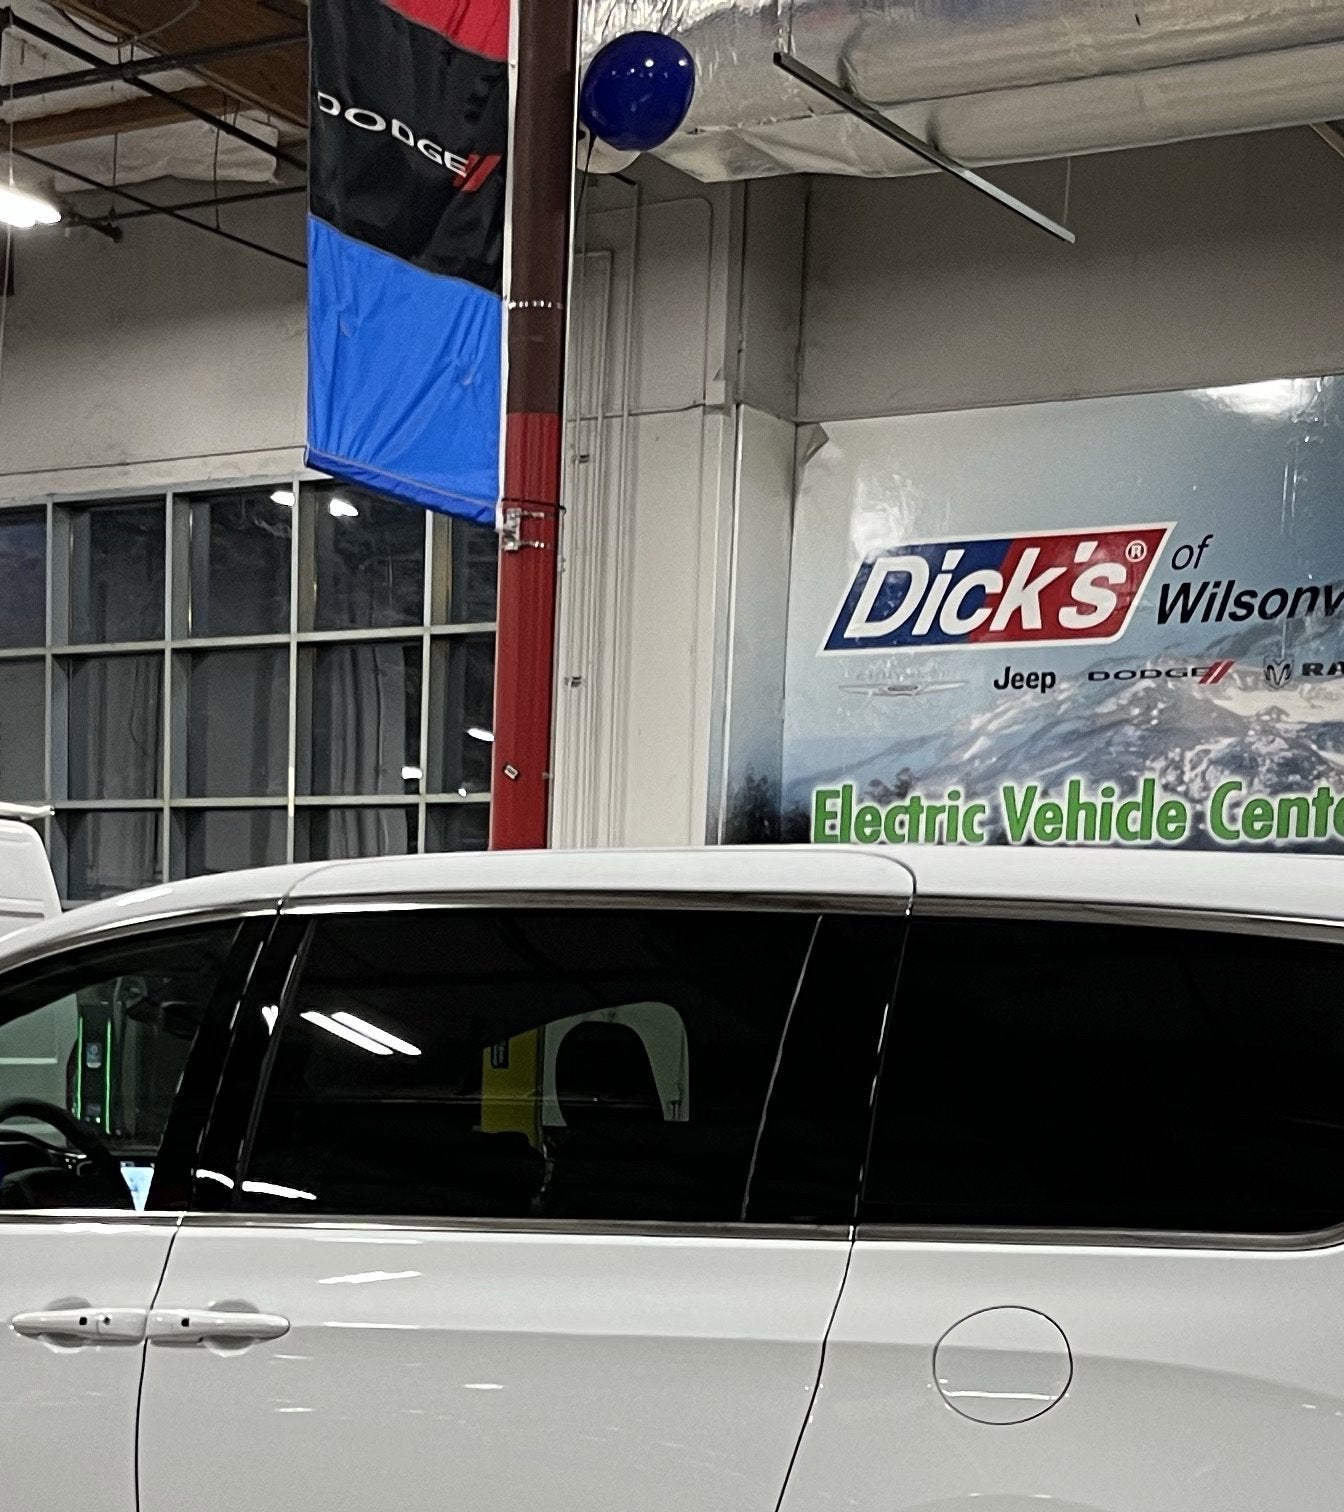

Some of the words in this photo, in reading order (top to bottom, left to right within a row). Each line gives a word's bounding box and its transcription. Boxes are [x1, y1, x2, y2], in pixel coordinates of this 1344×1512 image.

[317, 90, 469, 178] DODGE
[1171, 534, 1214, 571] of
[993, 666, 1057, 694] Jeep
[1087, 666, 1214, 682] DODGE
[813, 784, 987, 843] Electric
[1003, 778, 1188, 841] Vehicle
